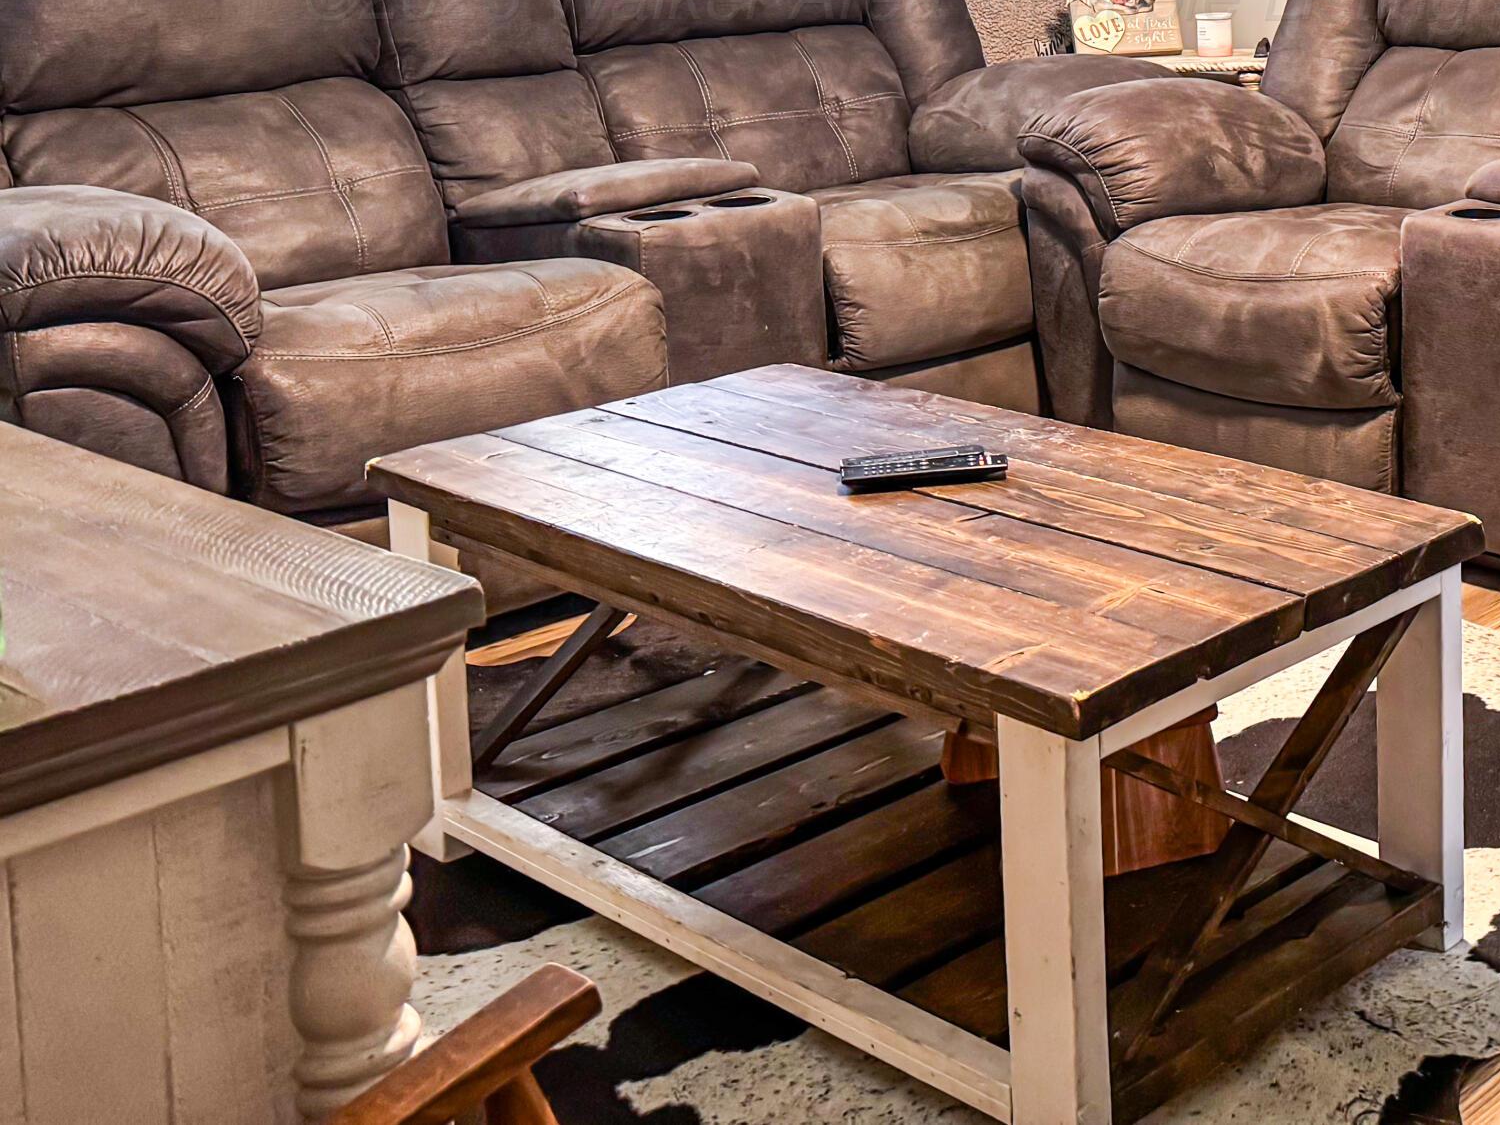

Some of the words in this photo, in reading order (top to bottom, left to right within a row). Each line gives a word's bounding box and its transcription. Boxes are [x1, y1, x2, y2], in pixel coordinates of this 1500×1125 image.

[1078, 17, 1124, 42] LOVE
[1143, 16, 1173, 32] first
[1135, 31, 1167, 50] sight
